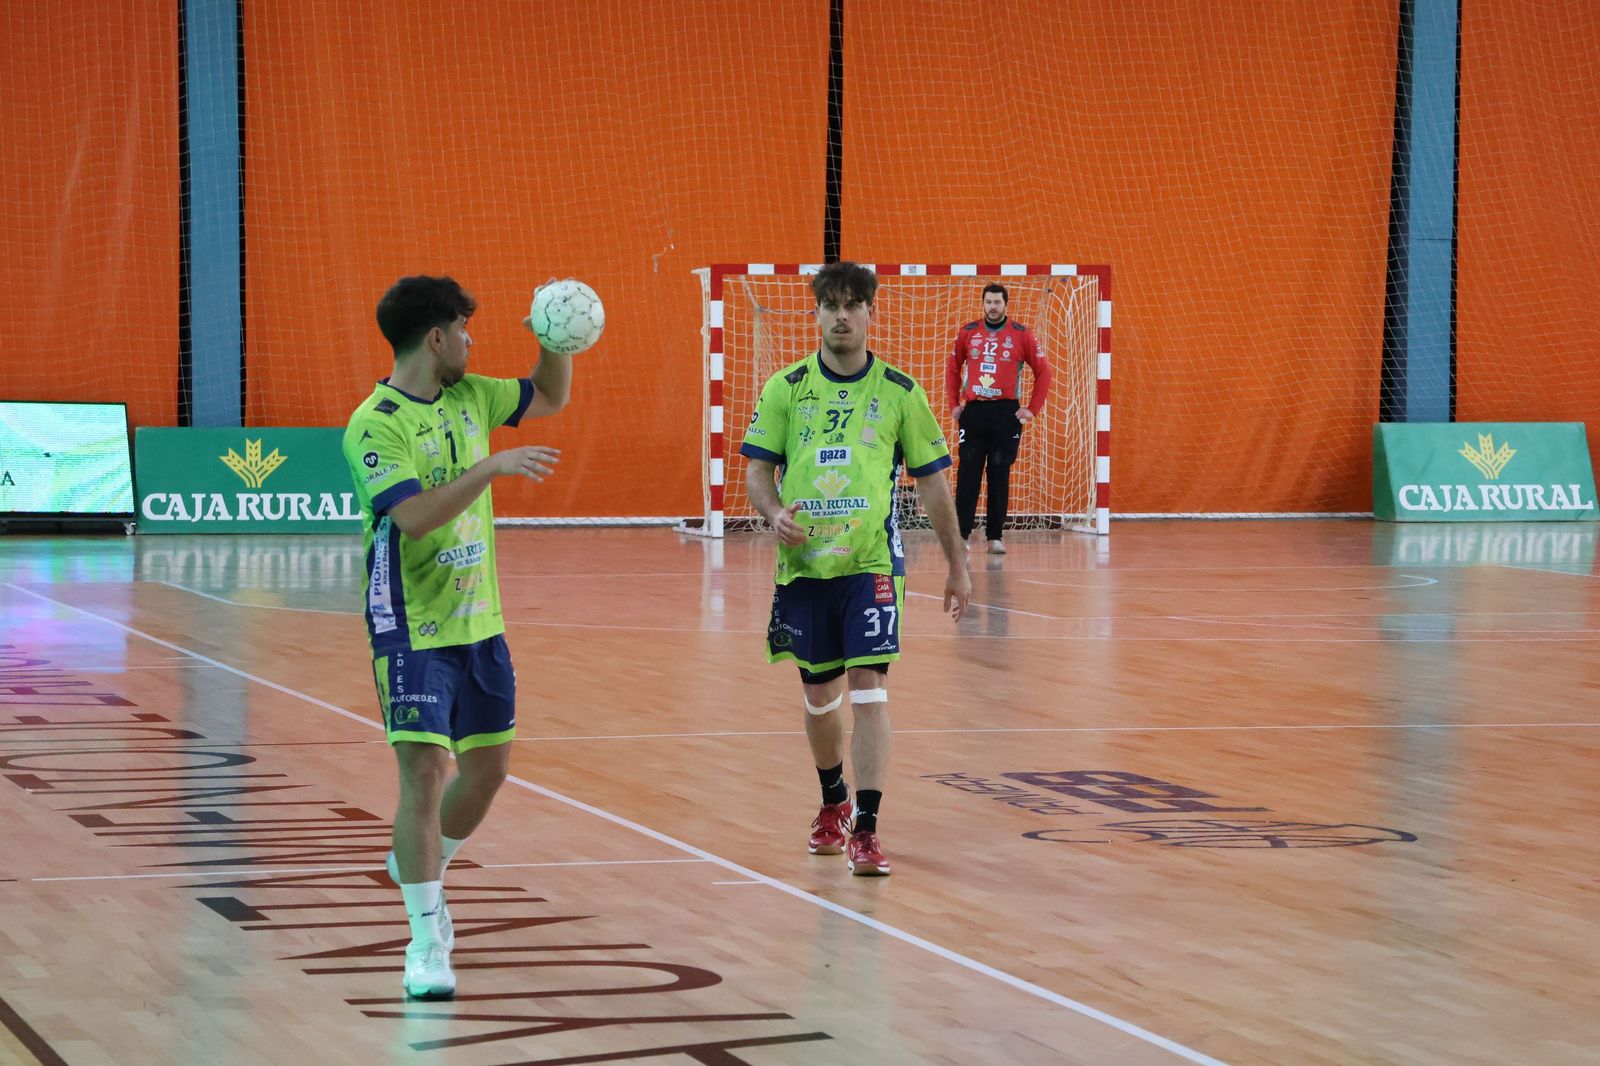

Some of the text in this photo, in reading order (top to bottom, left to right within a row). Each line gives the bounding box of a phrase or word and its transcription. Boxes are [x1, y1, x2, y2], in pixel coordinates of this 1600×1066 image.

[983, 342, 998, 355] 12
[823, 408, 854, 434] 37
[820, 449, 846, 463] gaza
[365, 462, 399, 483] ORALEJO
[142, 493, 362, 522] CAJA RURAL
[796, 499, 868, 511] AJA RURAL
[1399, 484, 1594, 512] CAJA RURAL
[864, 606, 896, 637] 37
[1000, 770, 1276, 813] FEB
